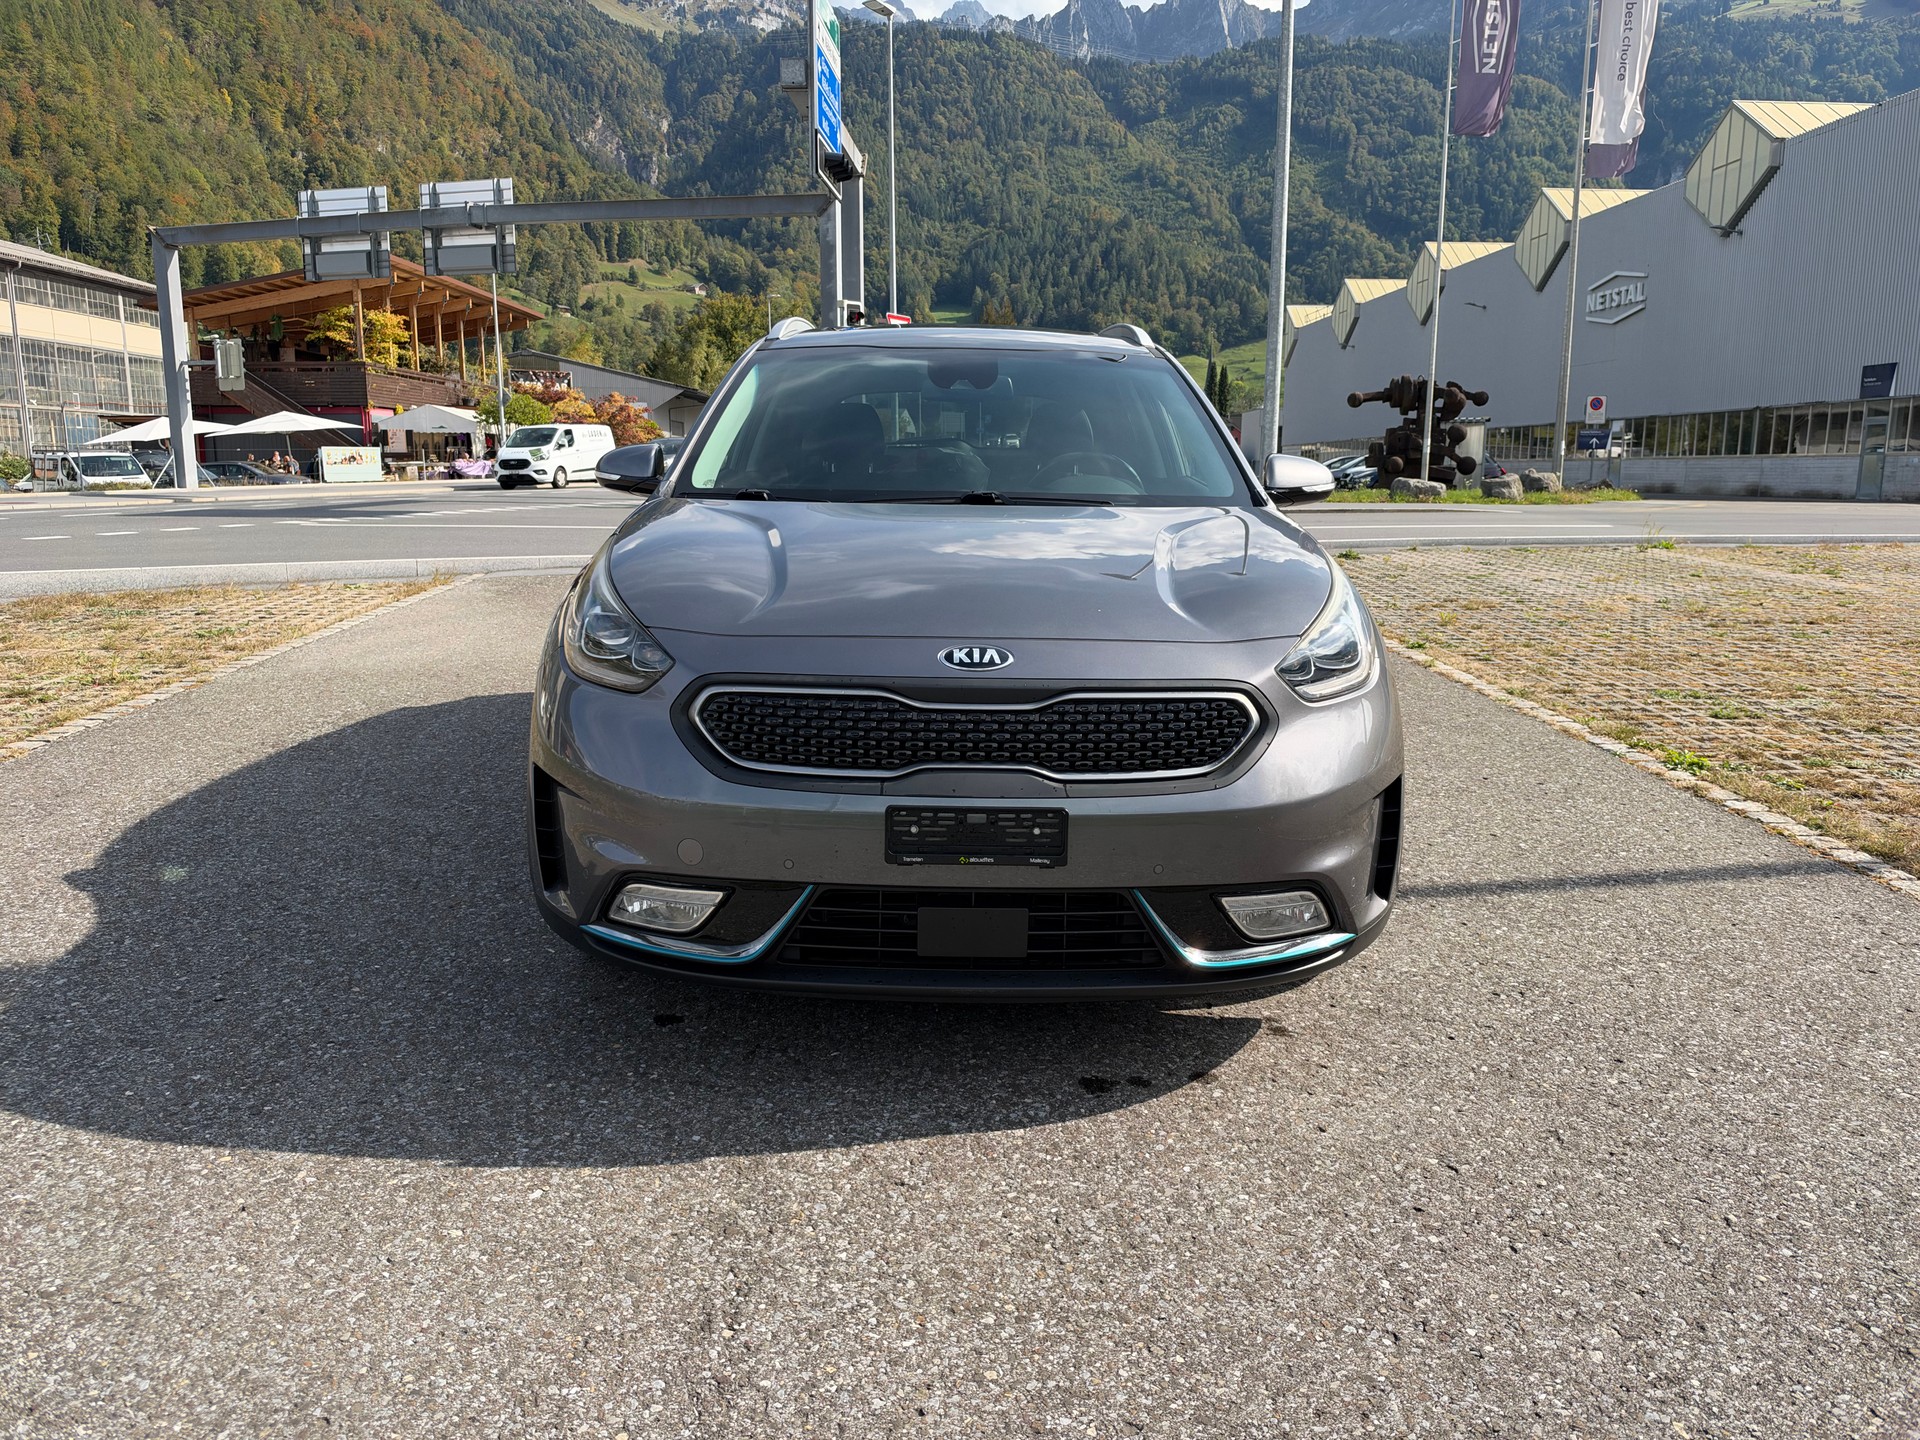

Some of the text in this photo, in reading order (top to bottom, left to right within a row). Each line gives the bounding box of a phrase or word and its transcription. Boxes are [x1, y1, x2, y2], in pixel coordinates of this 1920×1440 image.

[1617, 2, 1637, 81] best choice
[1586, 282, 1647, 313] NETSTAL
[953, 648, 1001, 664] KIA
